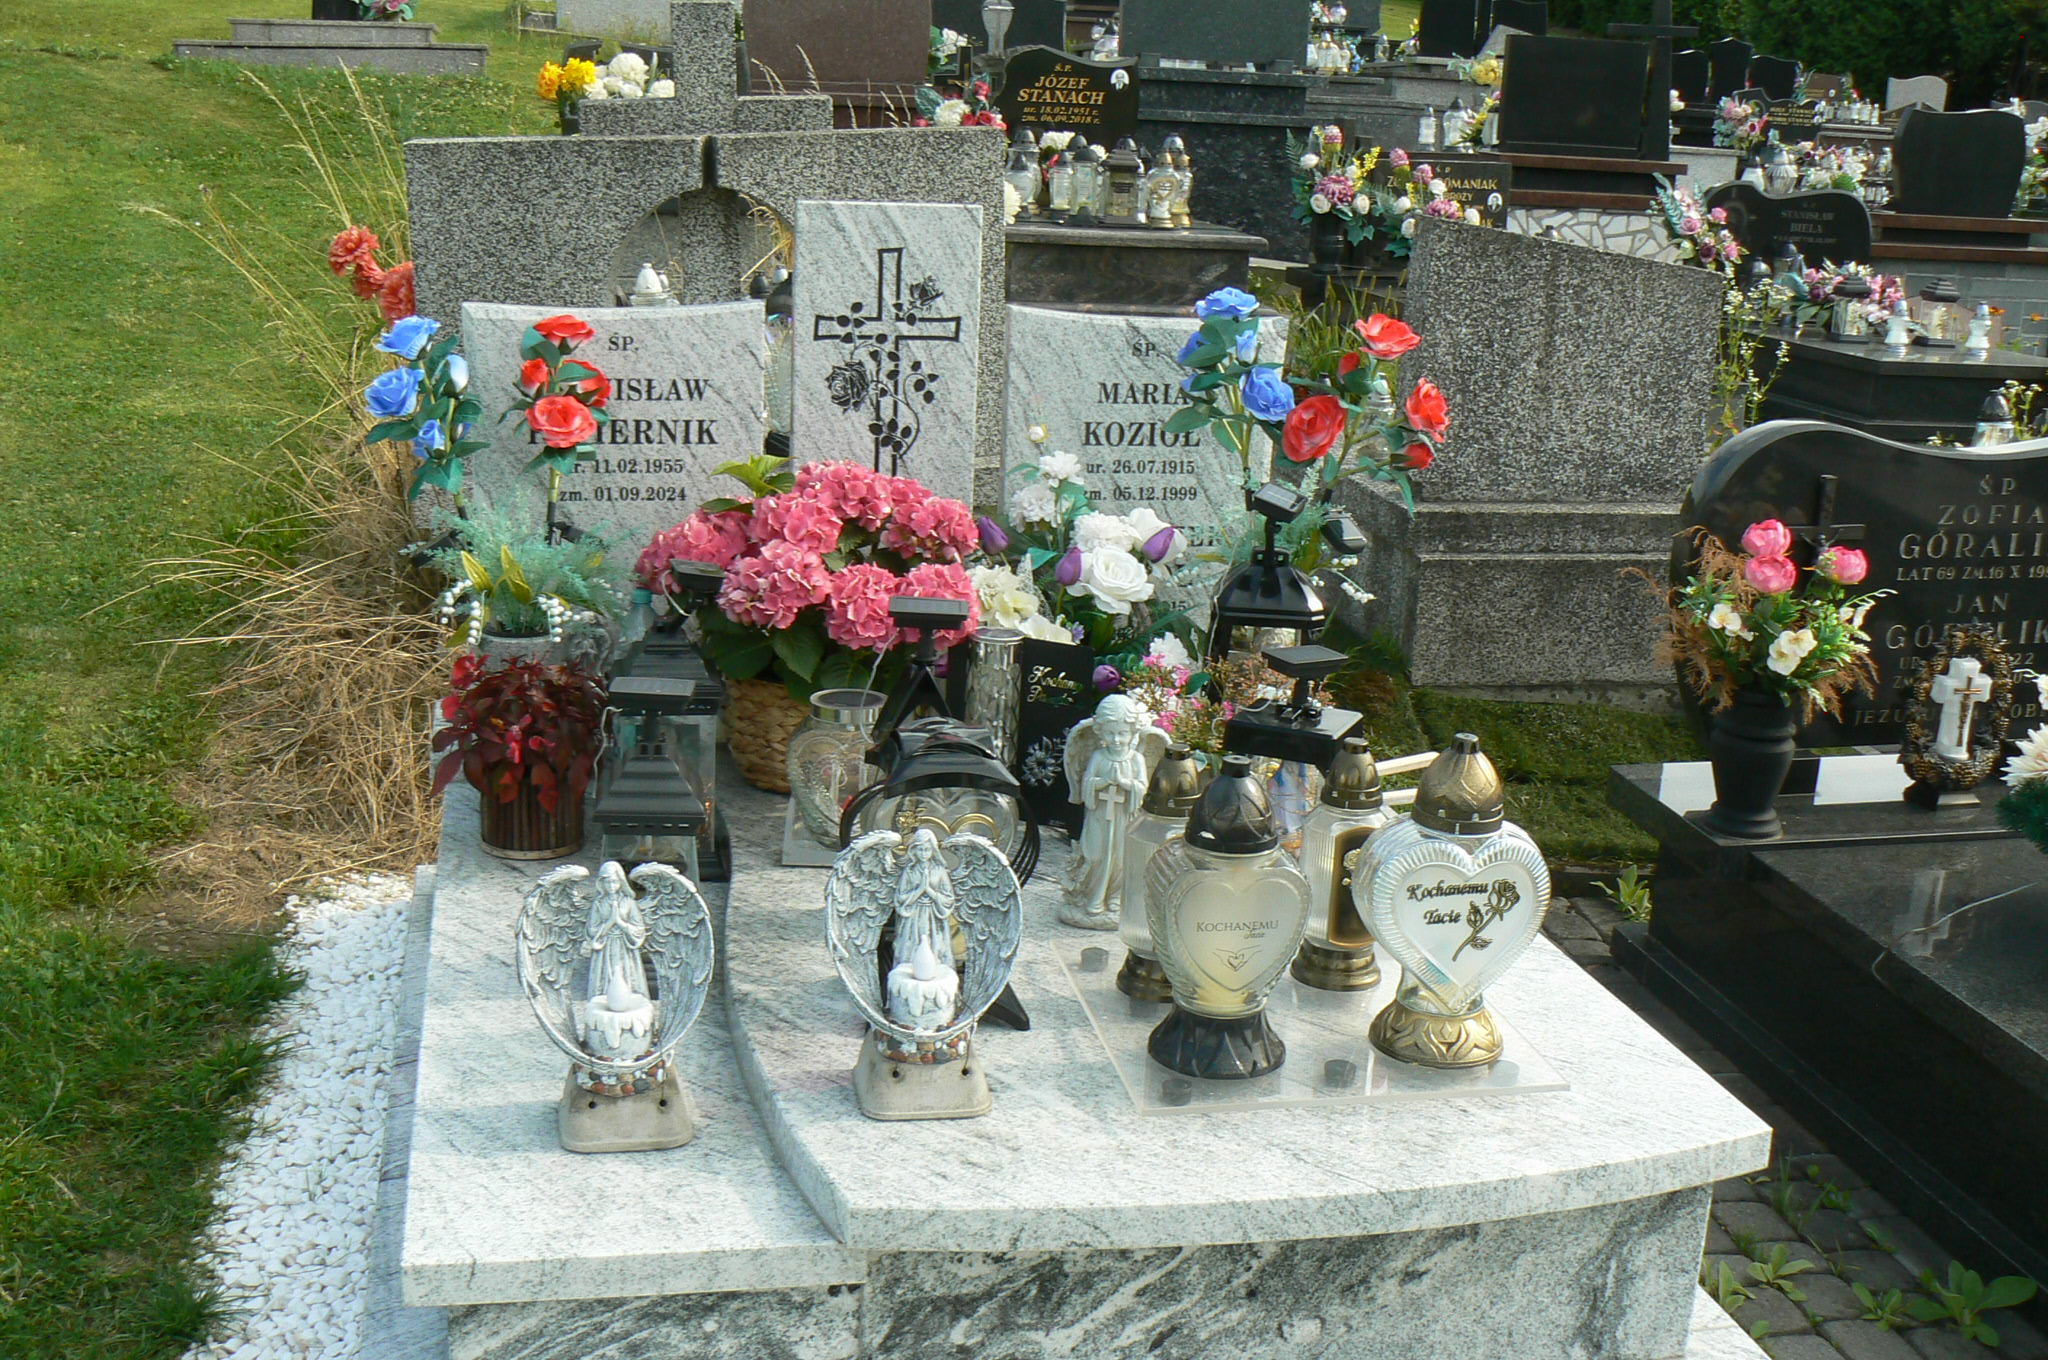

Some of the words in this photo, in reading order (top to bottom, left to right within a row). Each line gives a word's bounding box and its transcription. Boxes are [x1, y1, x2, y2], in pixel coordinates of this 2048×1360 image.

[1034, 74, 1090, 89] JÓZEF
[1017, 88, 1106, 105] STANACH
[1444, 177, 1498, 190] OMANIAK
[608, 332, 639, 351] ŚP.
[1132, 338, 1160, 356] ŚP.
[1098, 383, 1191, 404] MARIA
[594, 459, 684, 474] 11.02.1955
[1086, 462, 1106, 474] ur.
[1112, 460, 1195, 474] 26.07.1915
[559, 490, 588, 501] zm.
[594, 487, 687, 502] 01.09.2024
[1113, 487, 1197, 501] 05.12.1999
[1937, 504, 2045, 525] ZOFIA
[1899, 529, 2048, 559] GÓRALI
[1896, 567, 1934, 581] LAT
[1936, 566, 1955, 580] 69
[1948, 593, 2009, 614] JAN
[1407, 880, 1488, 901] Kochanemu
[1424, 908, 1462, 925] Tacie
[1196, 920, 1279, 932] KOCHANEMU
